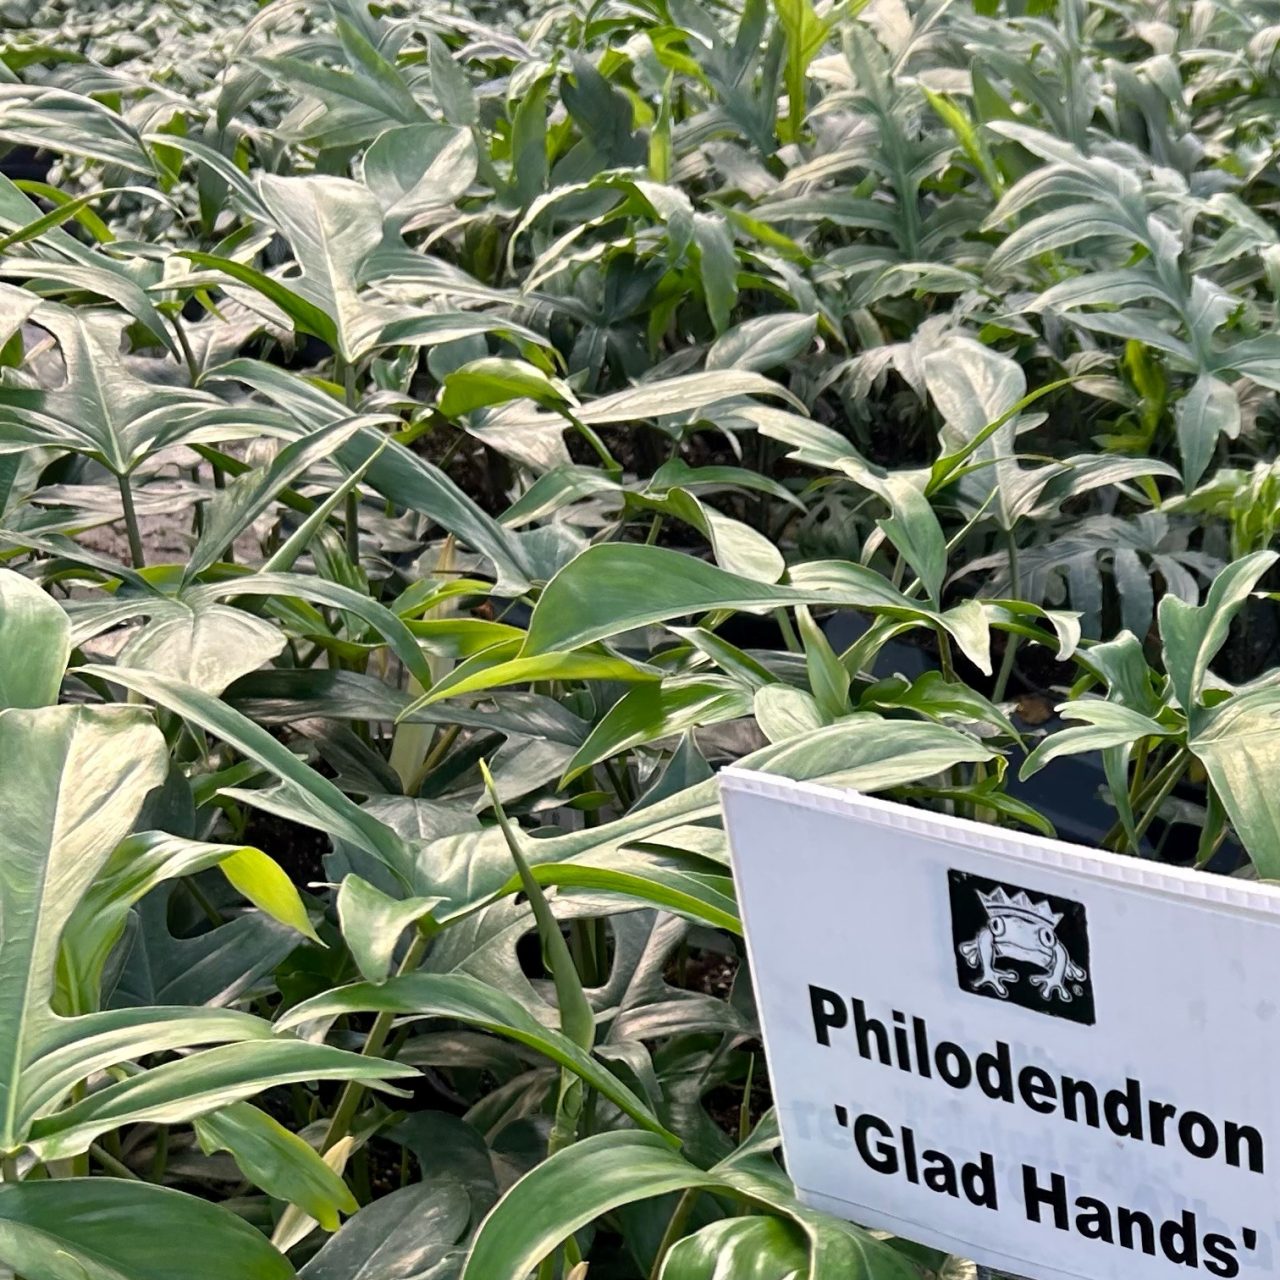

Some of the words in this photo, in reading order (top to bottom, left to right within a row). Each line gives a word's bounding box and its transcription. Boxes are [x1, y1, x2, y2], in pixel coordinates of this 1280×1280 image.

[808, 984, 1264, 1174] Philodendron
[834, 1104, 999, 1211] 'Glad
[1021, 1163, 1258, 1279] Hands'
